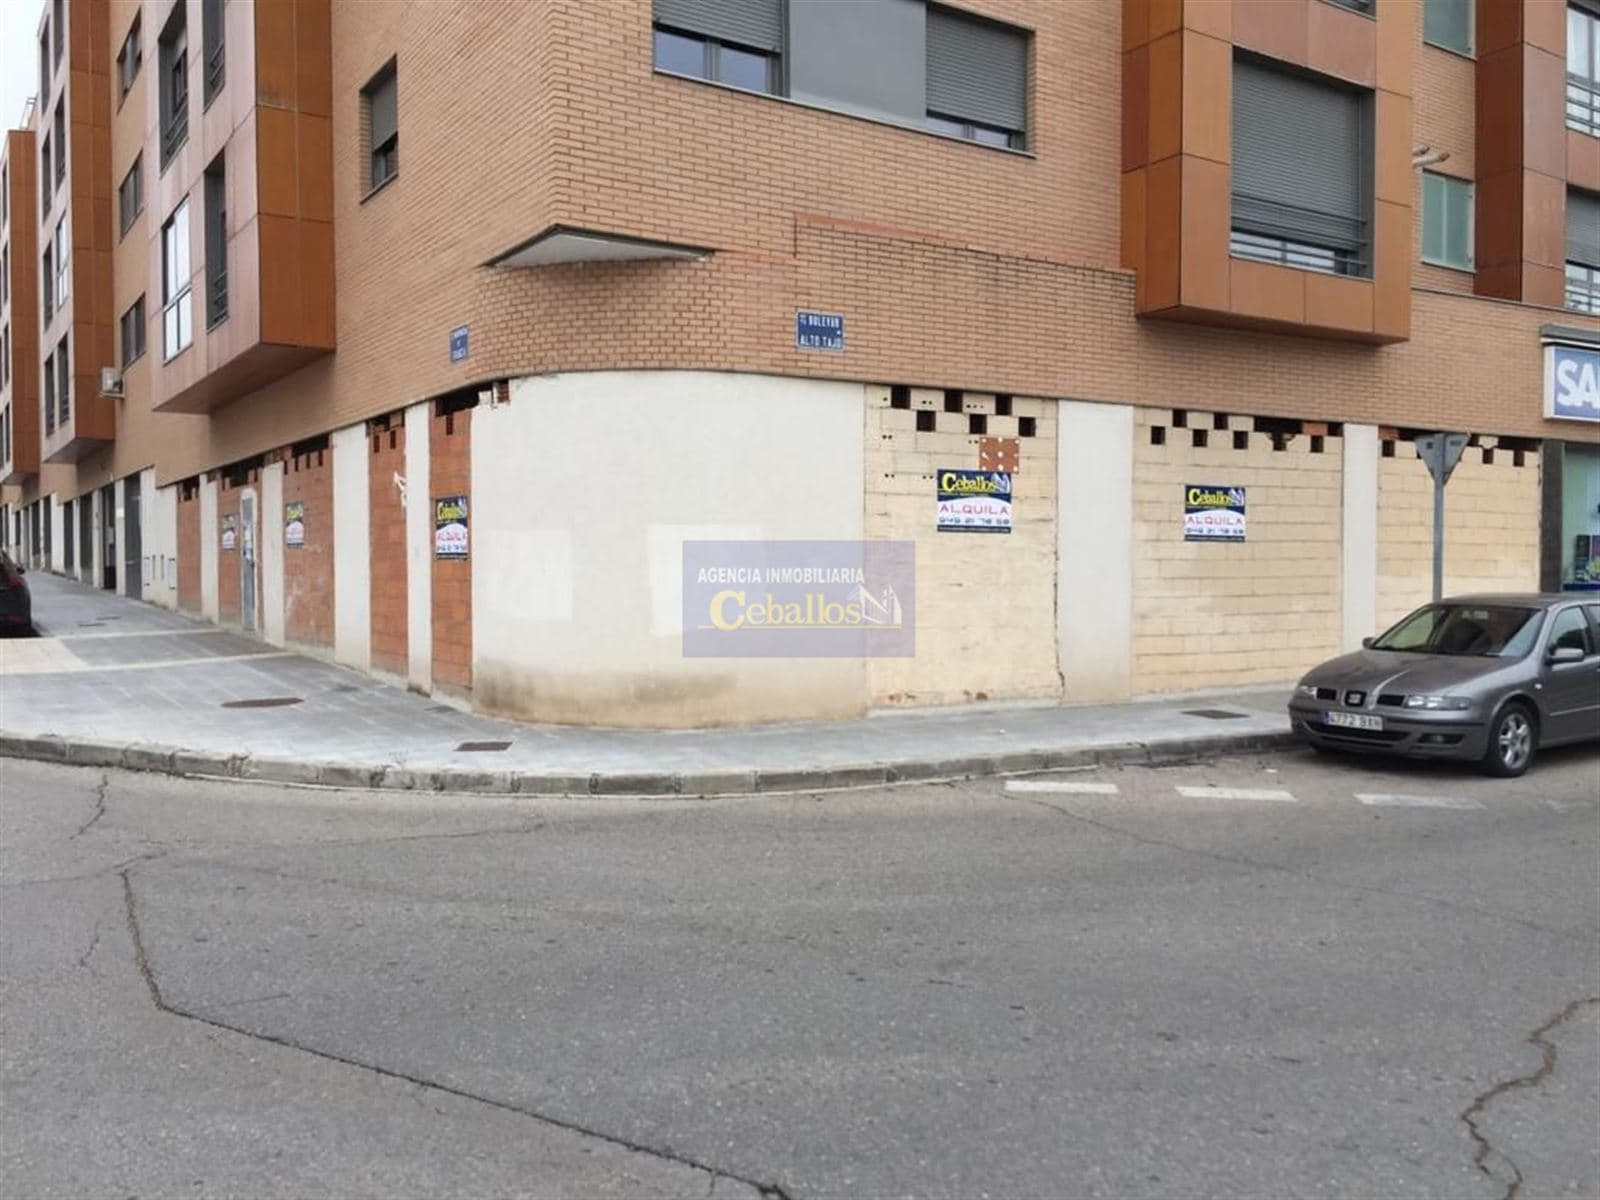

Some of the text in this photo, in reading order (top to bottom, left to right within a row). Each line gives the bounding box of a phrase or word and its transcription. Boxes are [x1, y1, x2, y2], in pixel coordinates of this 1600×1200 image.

[941, 472, 996, 492] Ceballos
[940, 503, 1009, 515] ALQUILA
[1187, 516, 1243, 526] ALQUILA
